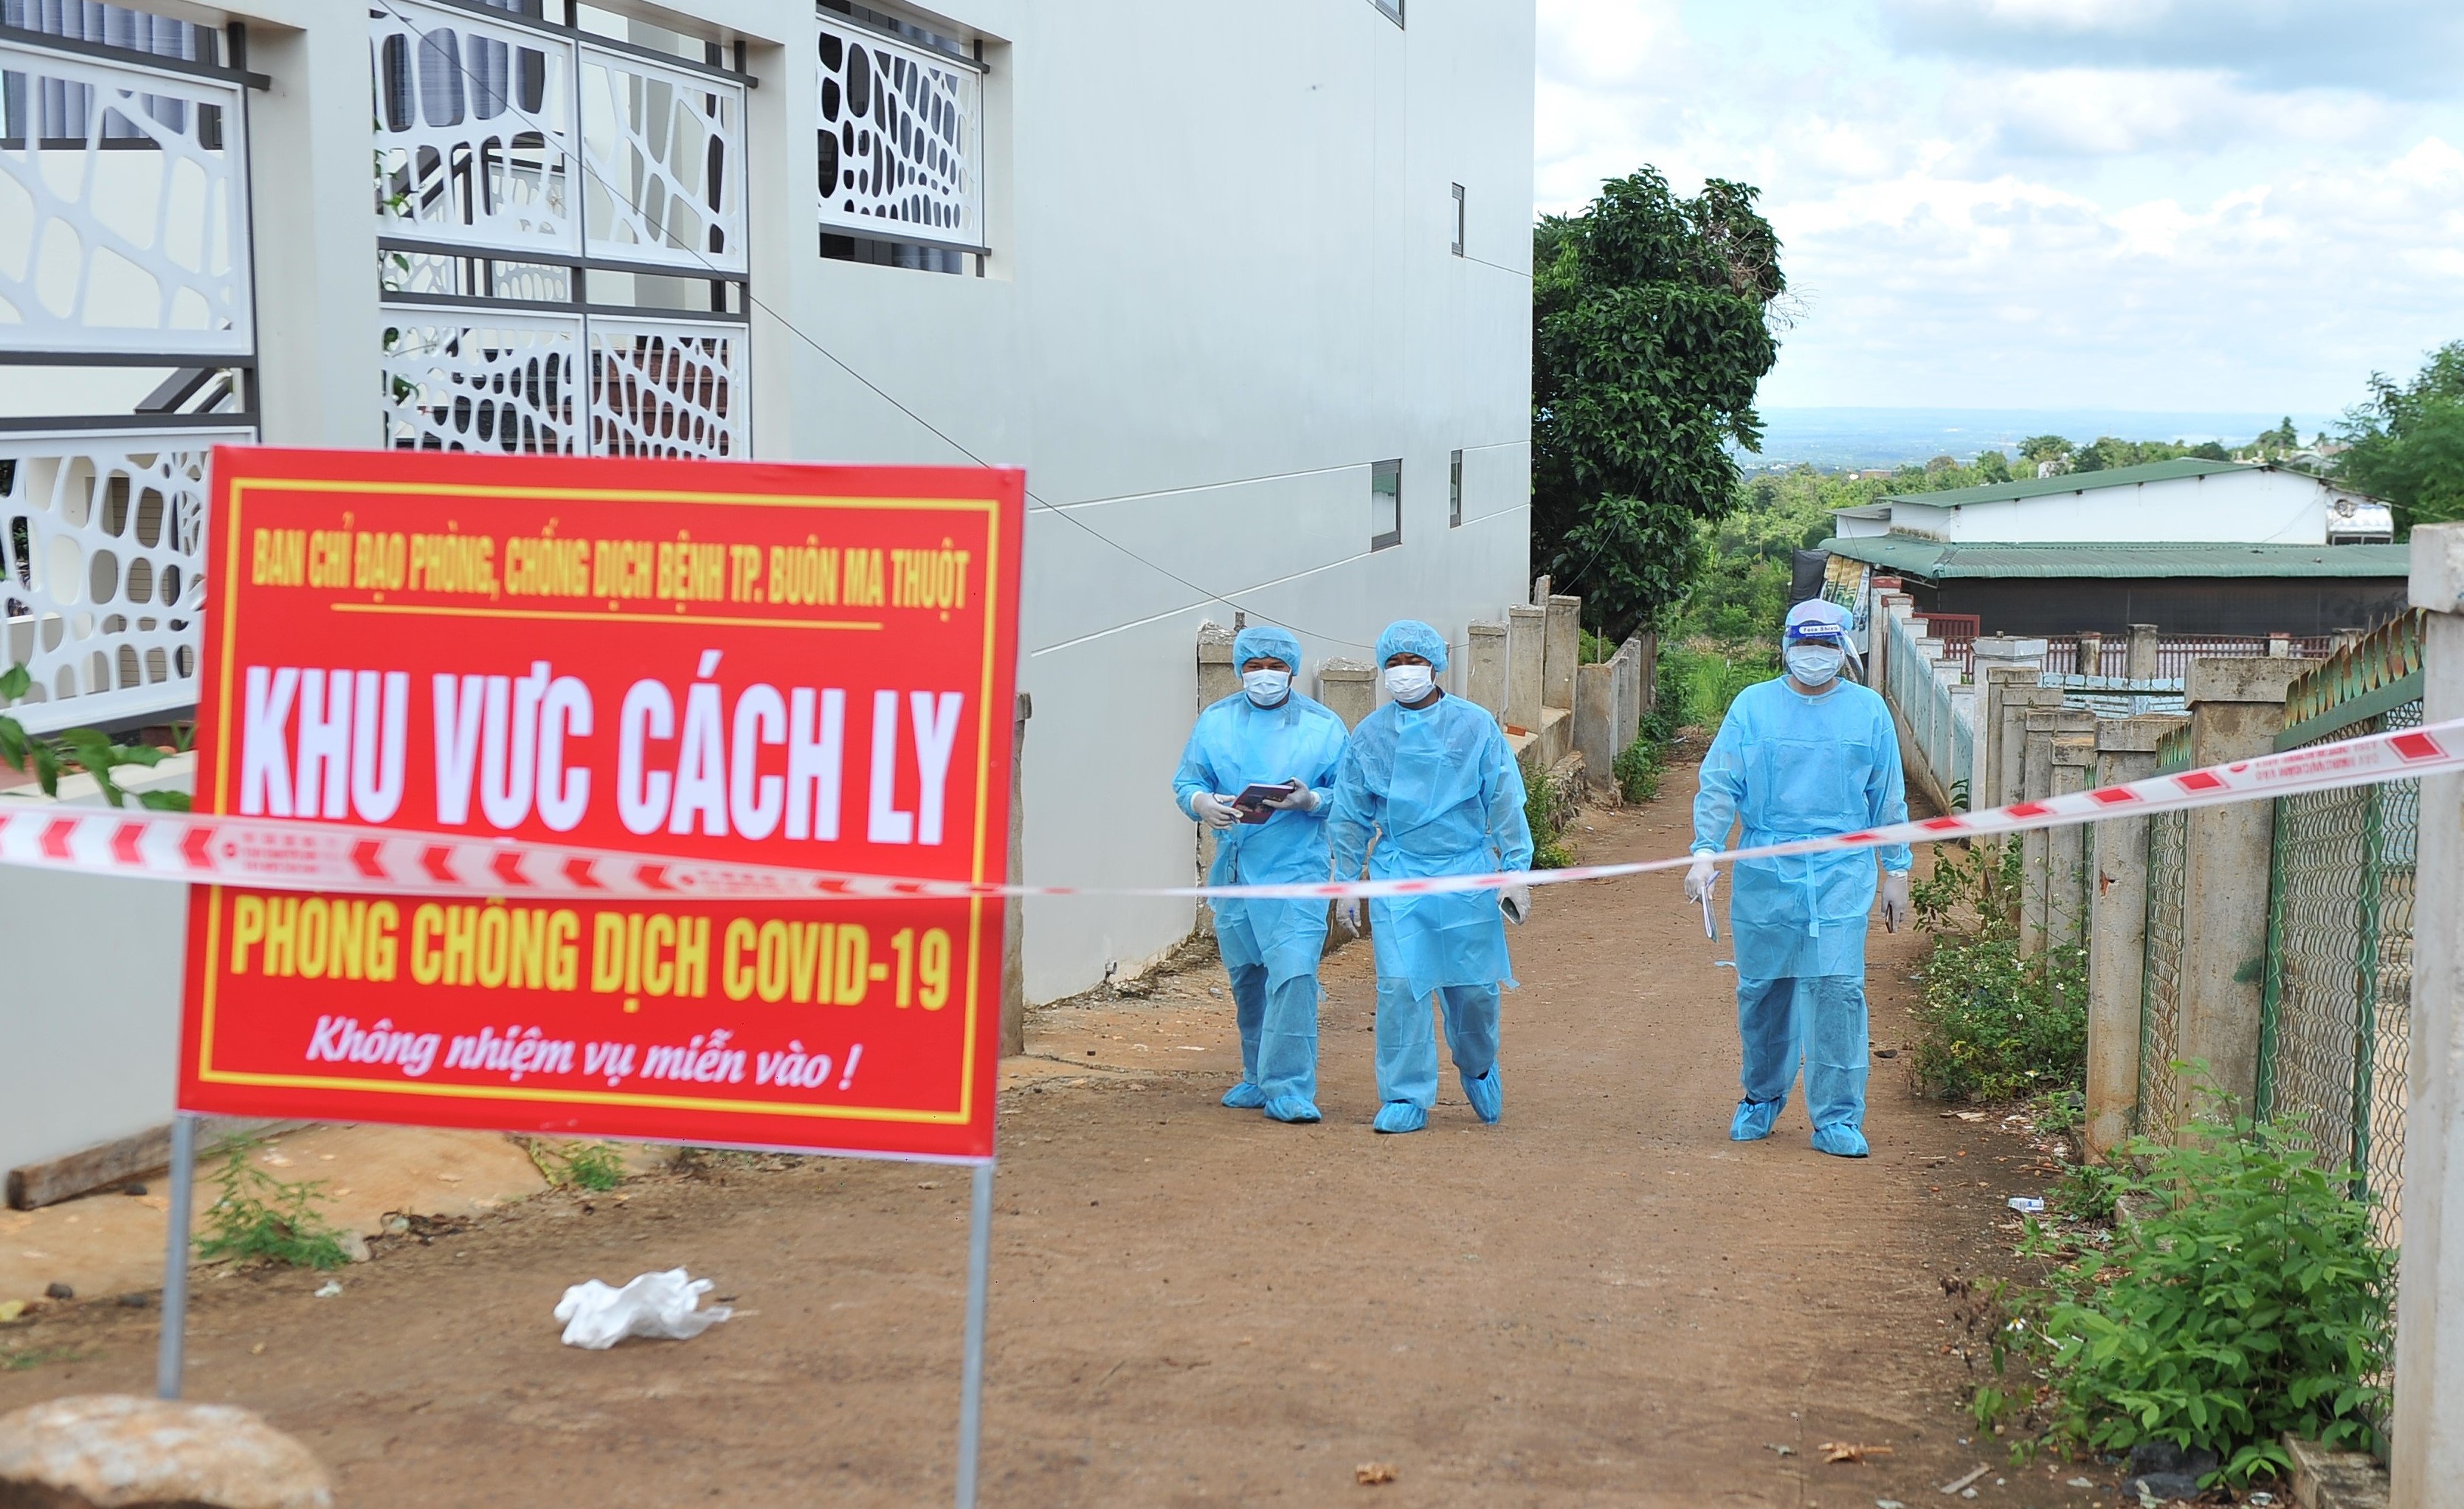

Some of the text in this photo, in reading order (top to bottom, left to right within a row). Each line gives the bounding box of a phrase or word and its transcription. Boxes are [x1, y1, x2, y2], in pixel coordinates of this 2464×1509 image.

[252, 511, 971, 623] BAN CHỈ ĐẠO PHÒNG, CHỐNG DỊCH BỆNH TP. BUÔN MA THUỘT
[240, 666, 410, 823] KHU
[616, 649, 846, 841] CÁCH
[867, 689, 964, 846] LY
[591, 911, 711, 1013] DỊCH
[722, 916, 952, 1012] COVID-19
[306, 1014, 863, 1091] Không nhiệm vụ miễn vào !
